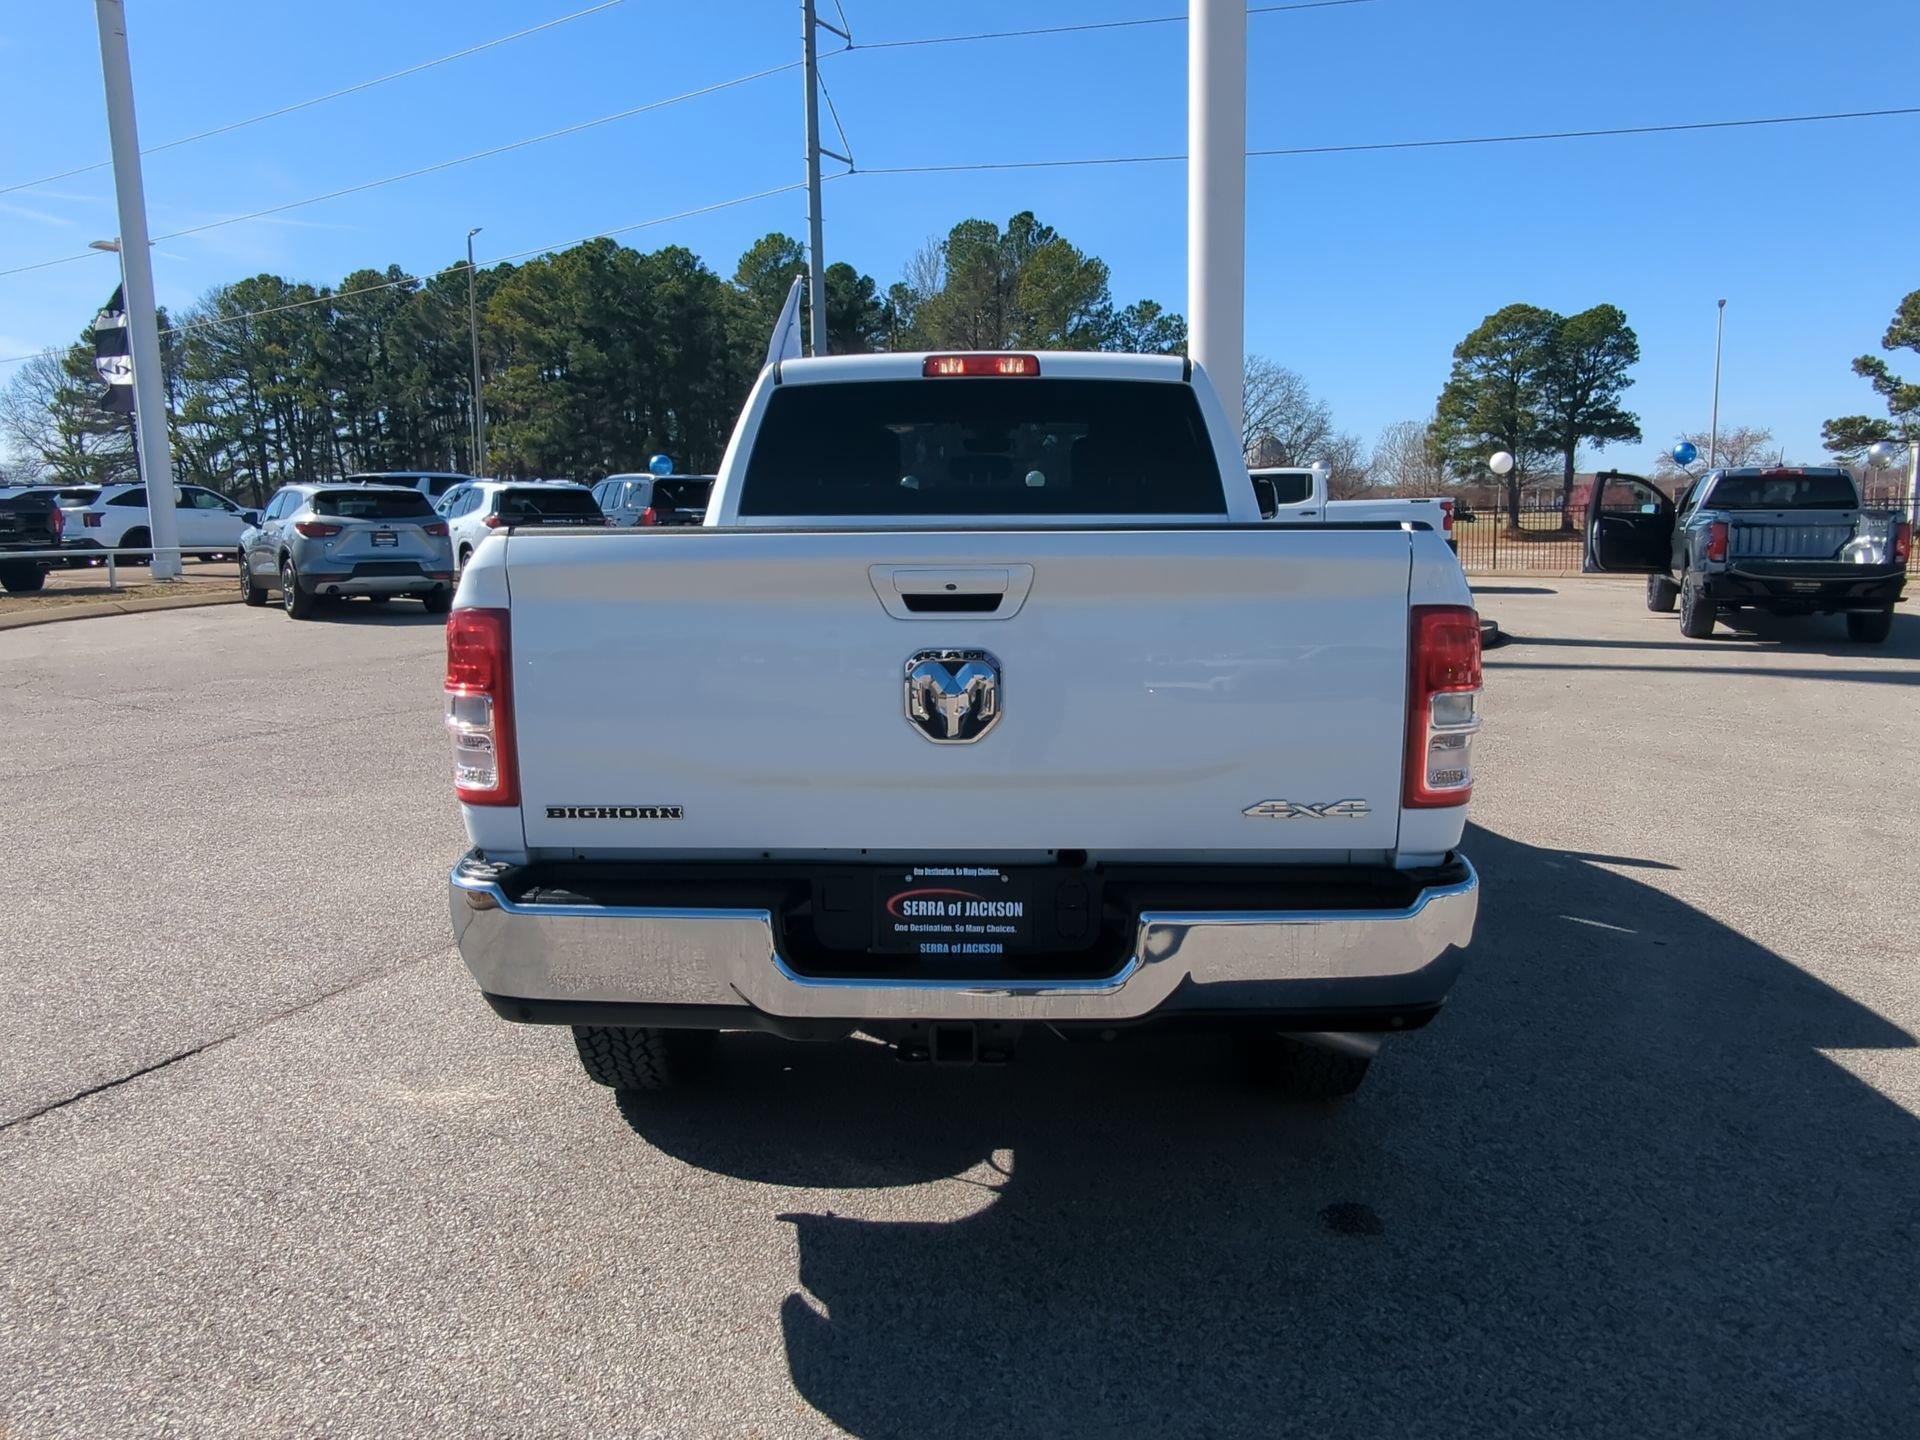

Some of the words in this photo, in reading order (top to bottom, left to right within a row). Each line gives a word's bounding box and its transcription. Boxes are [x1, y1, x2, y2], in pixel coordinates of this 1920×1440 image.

[924, 651, 984, 660] RAM
[545, 806, 683, 819] BIGHORN
[913, 867, 924, 876] One
[925, 867, 955, 876] Destination.
[955, 867, 963, 876] So
[963, 867, 977, 877] Many
[903, 901, 945, 916] SERRA
[948, 901, 961, 916] of
[965, 901, 1023, 917] JACKSON
[894, 923, 908, 932] One
[910, 923, 954, 932] Destination.
[955, 924, 964, 933] So
[966, 924, 985, 933] Many
[986, 924, 1017, 933] Choices.
[920, 943, 949, 953] SERRA
[951, 943, 962, 953] of
[962, 943, 1003, 953] JACKSON
